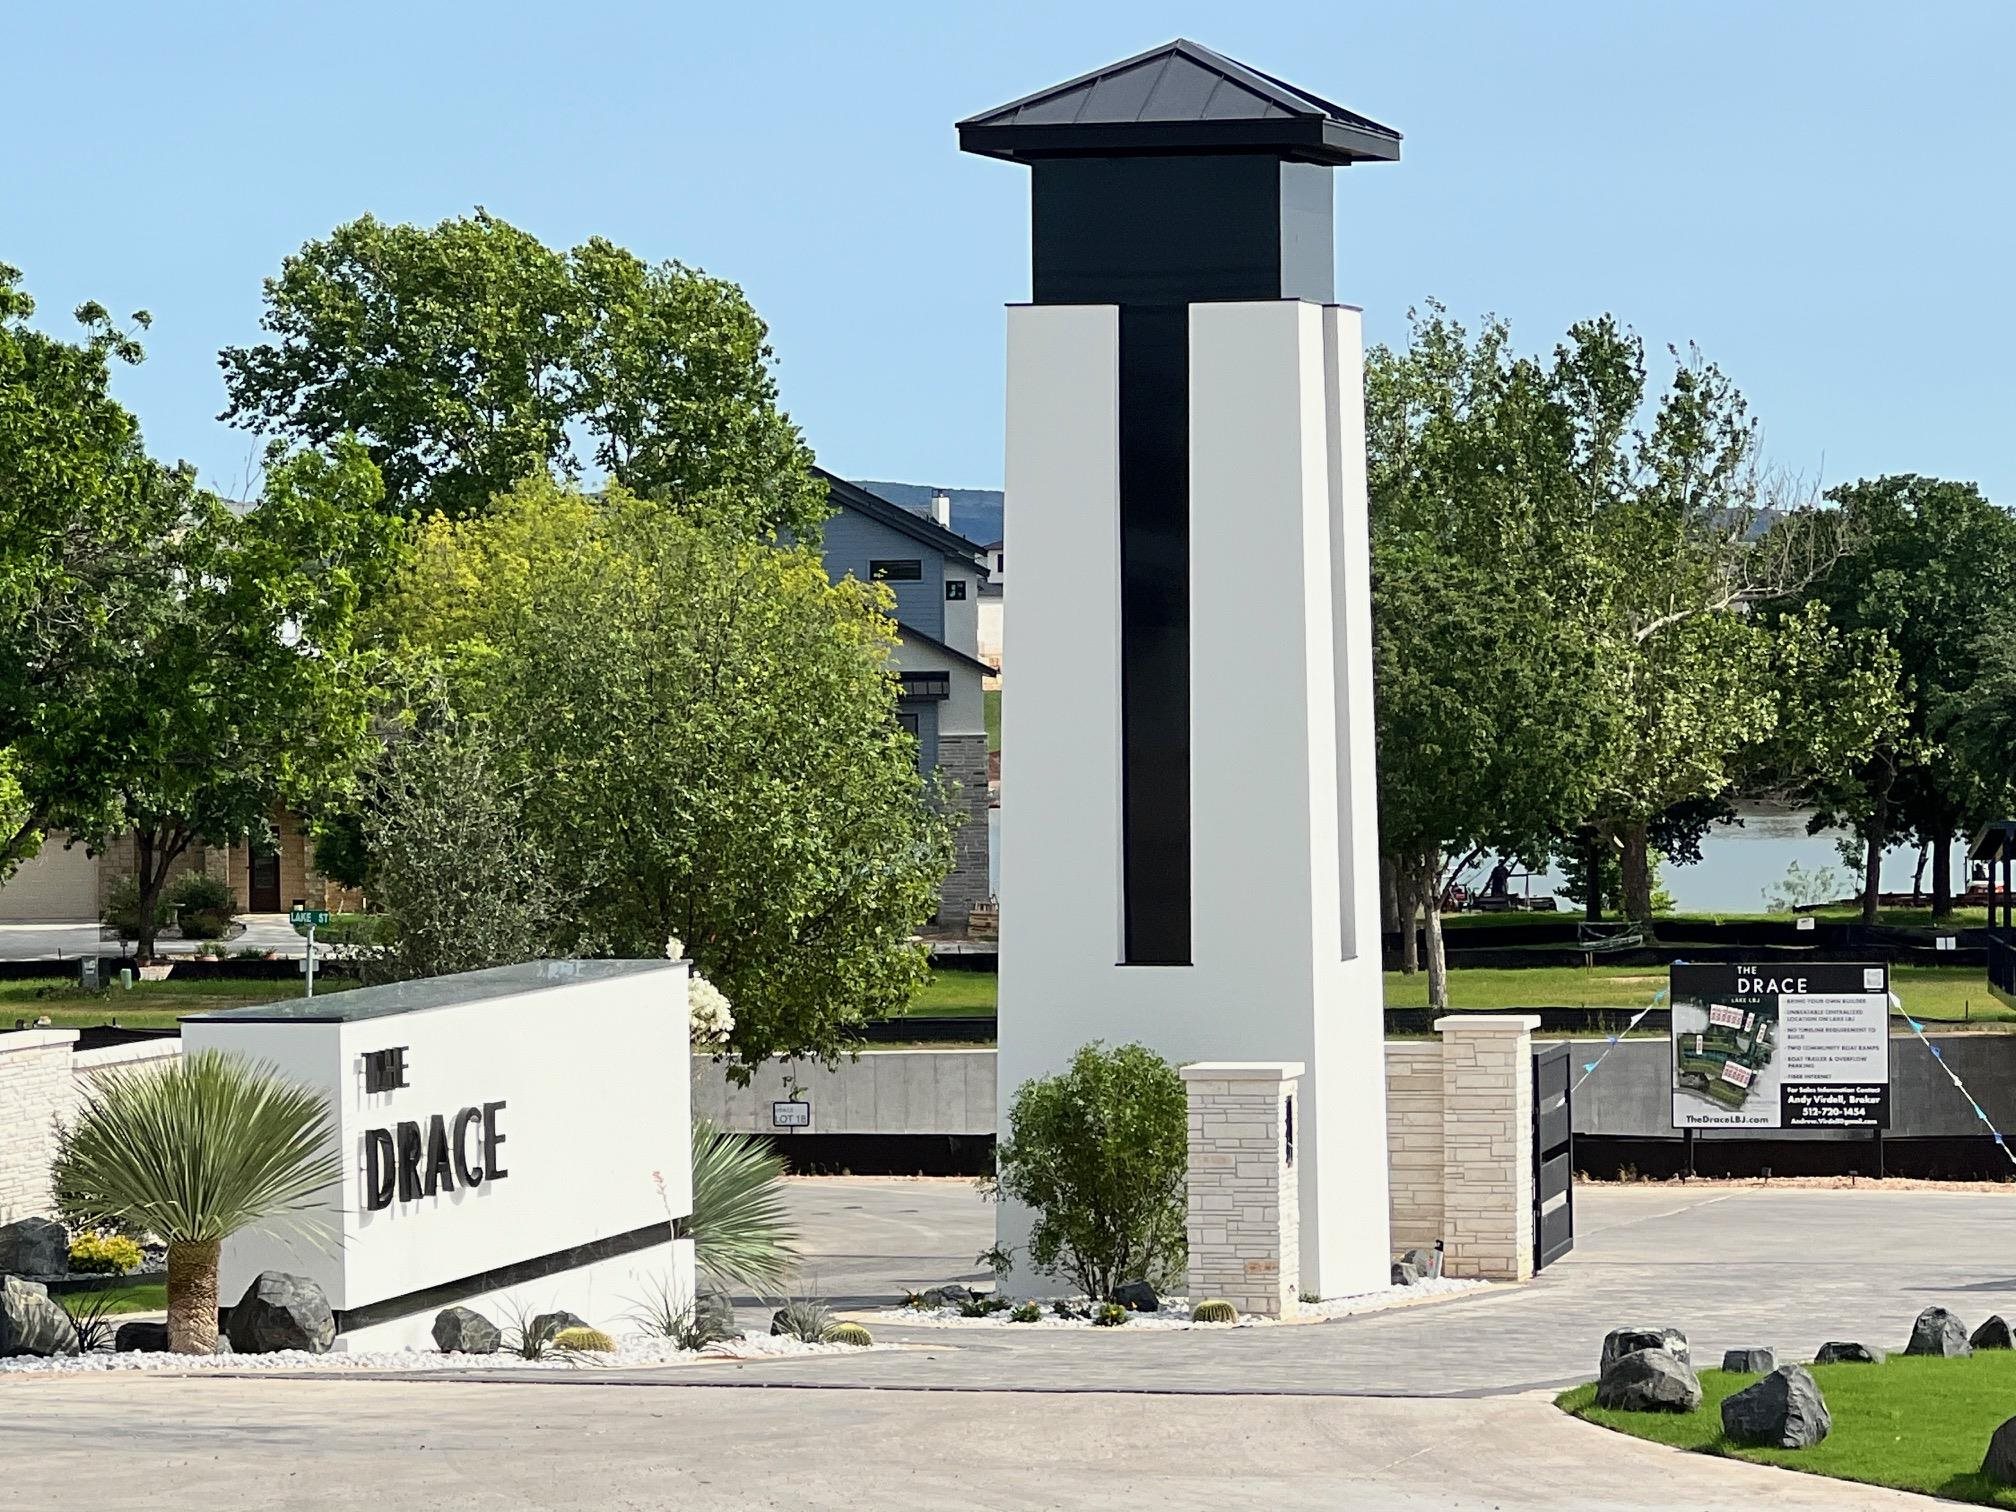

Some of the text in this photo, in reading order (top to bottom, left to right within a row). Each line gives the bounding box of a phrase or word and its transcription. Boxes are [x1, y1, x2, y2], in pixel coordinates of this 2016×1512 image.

[290, 912, 329, 924] LAKE ST
[1737, 965, 1757, 975] THE
[1737, 978, 1808, 994] DRACE
[361, 1045, 411, 1094] THE
[1817, 1086, 1855, 1094] Information
[1787, 1095, 1881, 1106] Andy Virdell, Broker
[1802, 1107, 1866, 1117] 512-720-1454
[774, 1114, 794, 1124] LOT
[1686, 1115, 1769, 1124] TheDraceLBJ.com
[365, 1099, 509, 1212] DRACE
